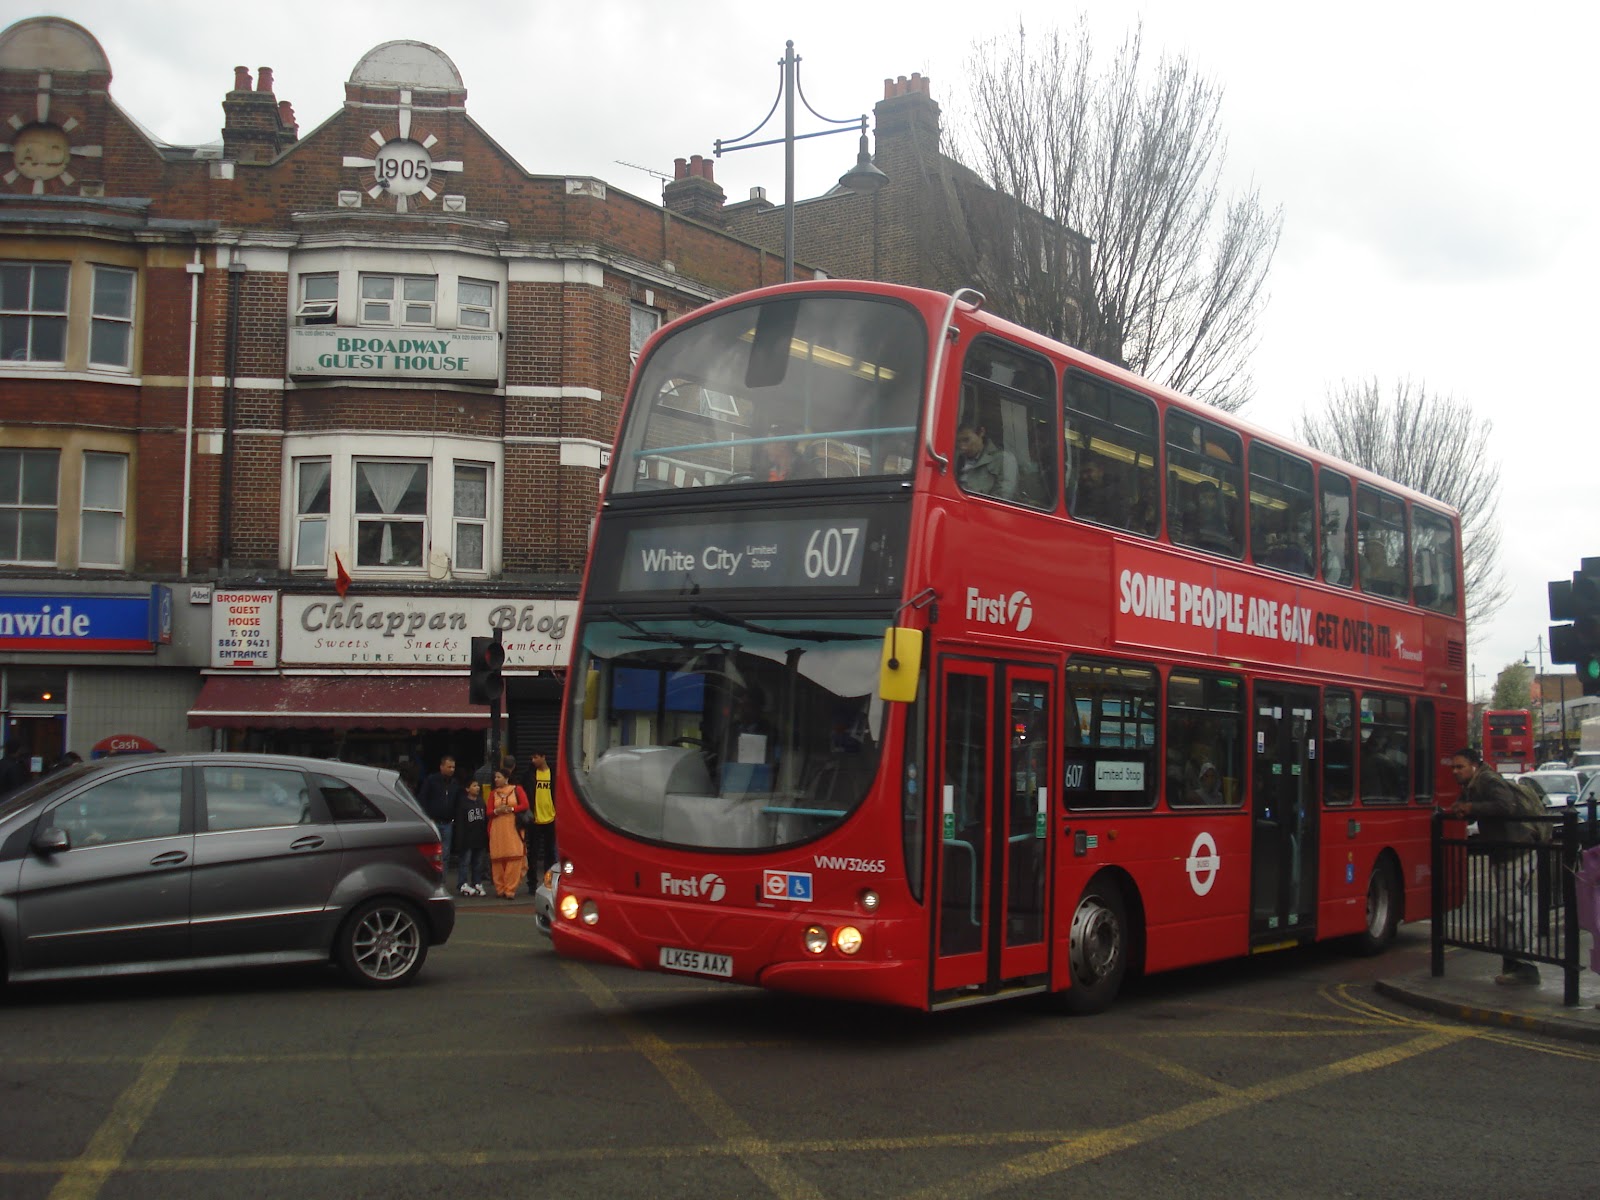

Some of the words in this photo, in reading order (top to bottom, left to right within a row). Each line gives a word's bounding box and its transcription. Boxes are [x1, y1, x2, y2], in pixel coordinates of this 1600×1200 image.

[378, 158, 428, 179] 1905
[337, 338, 450, 354] BROADWAY
[318, 354, 387, 369] GUEST
[395, 356, 469, 371] HOUSE
[746, 544, 777, 555] Limited
[804, 528, 860, 578] 607
[641, 549, 695, 572] White
[702, 546, 743, 576] City
[752, 558, 771, 570] Stop
[191, 591, 209, 599] Abel
[217, 594, 273, 603] BROADWAY
[229, 606, 260, 614] GUEST
[966, 587, 1006, 625] First
[1120, 569, 1175, 622] SOME
[1180, 582, 1243, 633] PEOPLE
[1246, 597, 1278, 639] ARE
[1281, 603, 1314, 646] GAY.
[1316, 611, 1339, 650] GET
[1343, 618, 1375, 656] OVER
[228, 618, 260, 626] HOUSE
[301, 602, 467, 637] Chhappan
[488, 604, 569, 640] Bhog
[314, 638, 369, 648] Sweets
[404, 638, 458, 651] Snacks
[352, 653, 394, 661] PURE
[111, 739, 139, 749] Cash
[1065, 765, 1083, 787] 607
[1098, 767, 1124, 780] Limited
[1126, 767, 1141, 784] Stop
[814, 855, 886, 873] VNW32665
[661, 873, 698, 897] First
[666, 950, 698, 968] LK55
[702, 955, 728, 973] AAX
